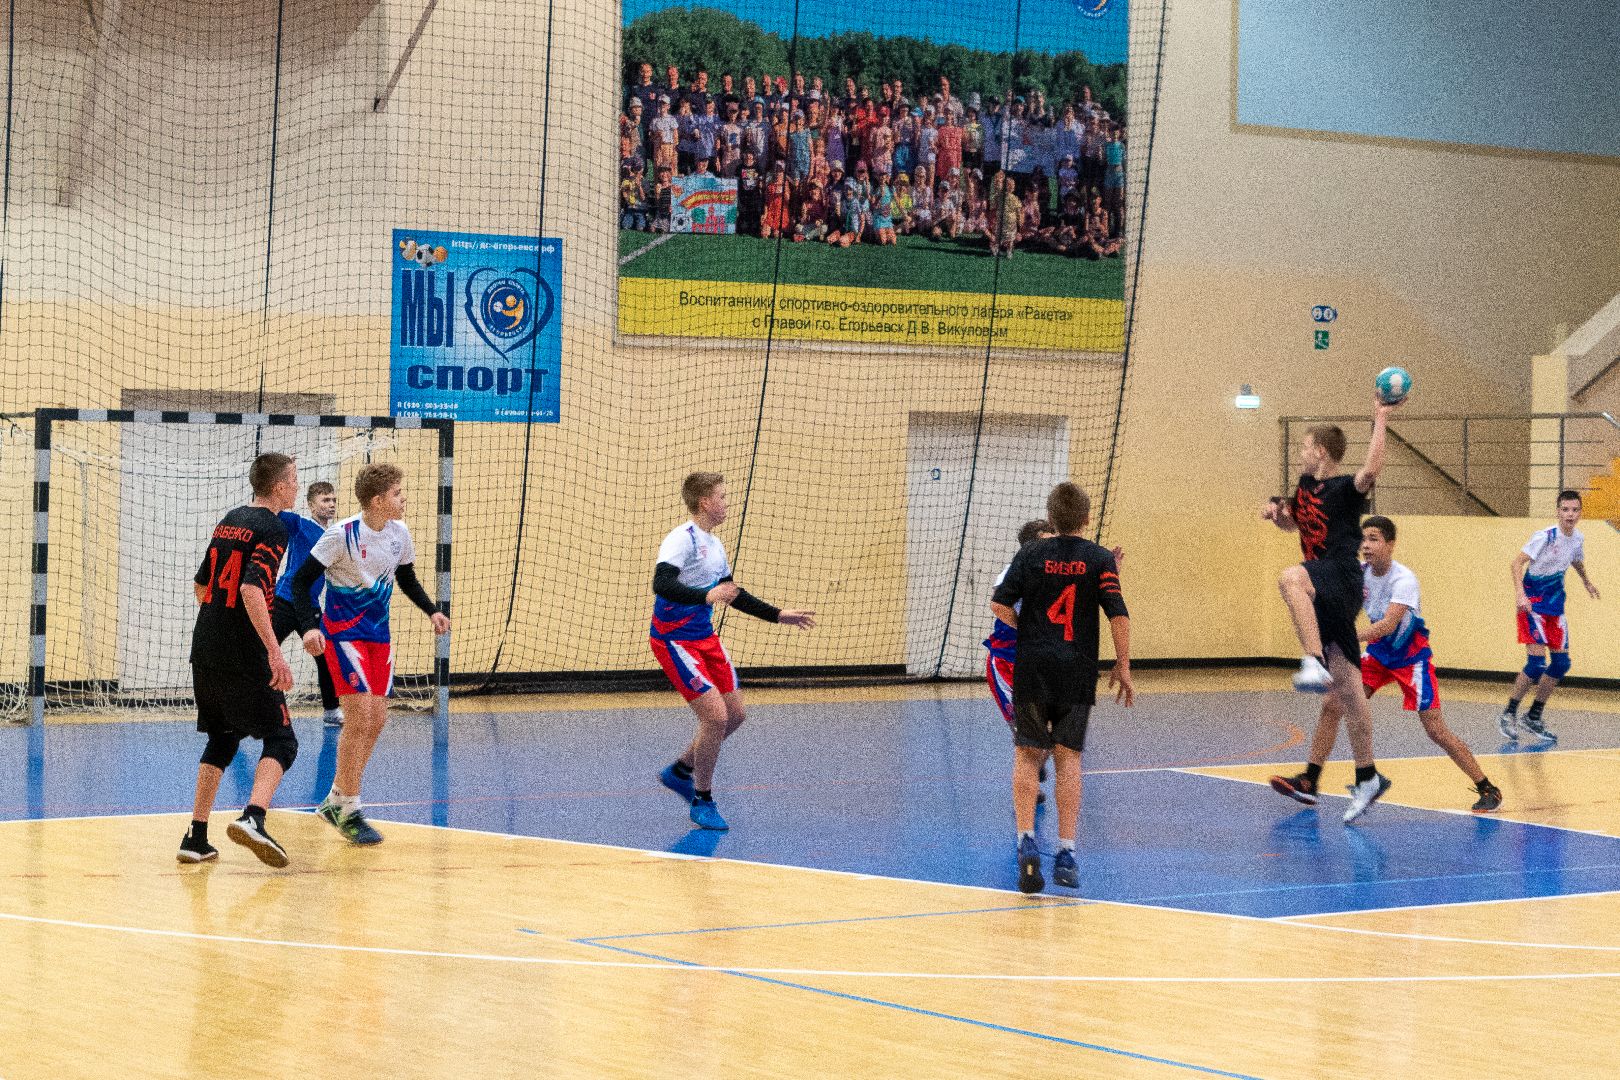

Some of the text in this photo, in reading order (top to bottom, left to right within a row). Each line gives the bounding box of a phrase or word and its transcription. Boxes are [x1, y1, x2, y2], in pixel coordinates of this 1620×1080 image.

[400, 269, 455, 348] МЫ
[679, 290, 1073, 322] Воспитанники спортивно-оздоровительного лагеря «Ракета»
[763, 314, 812, 330] Главой
[838, 317, 903, 334] Егорьевск
[938, 321, 1008, 338] Викуловым
[205, 547, 243, 609] 14
[1047, 583, 1077, 642] 4
